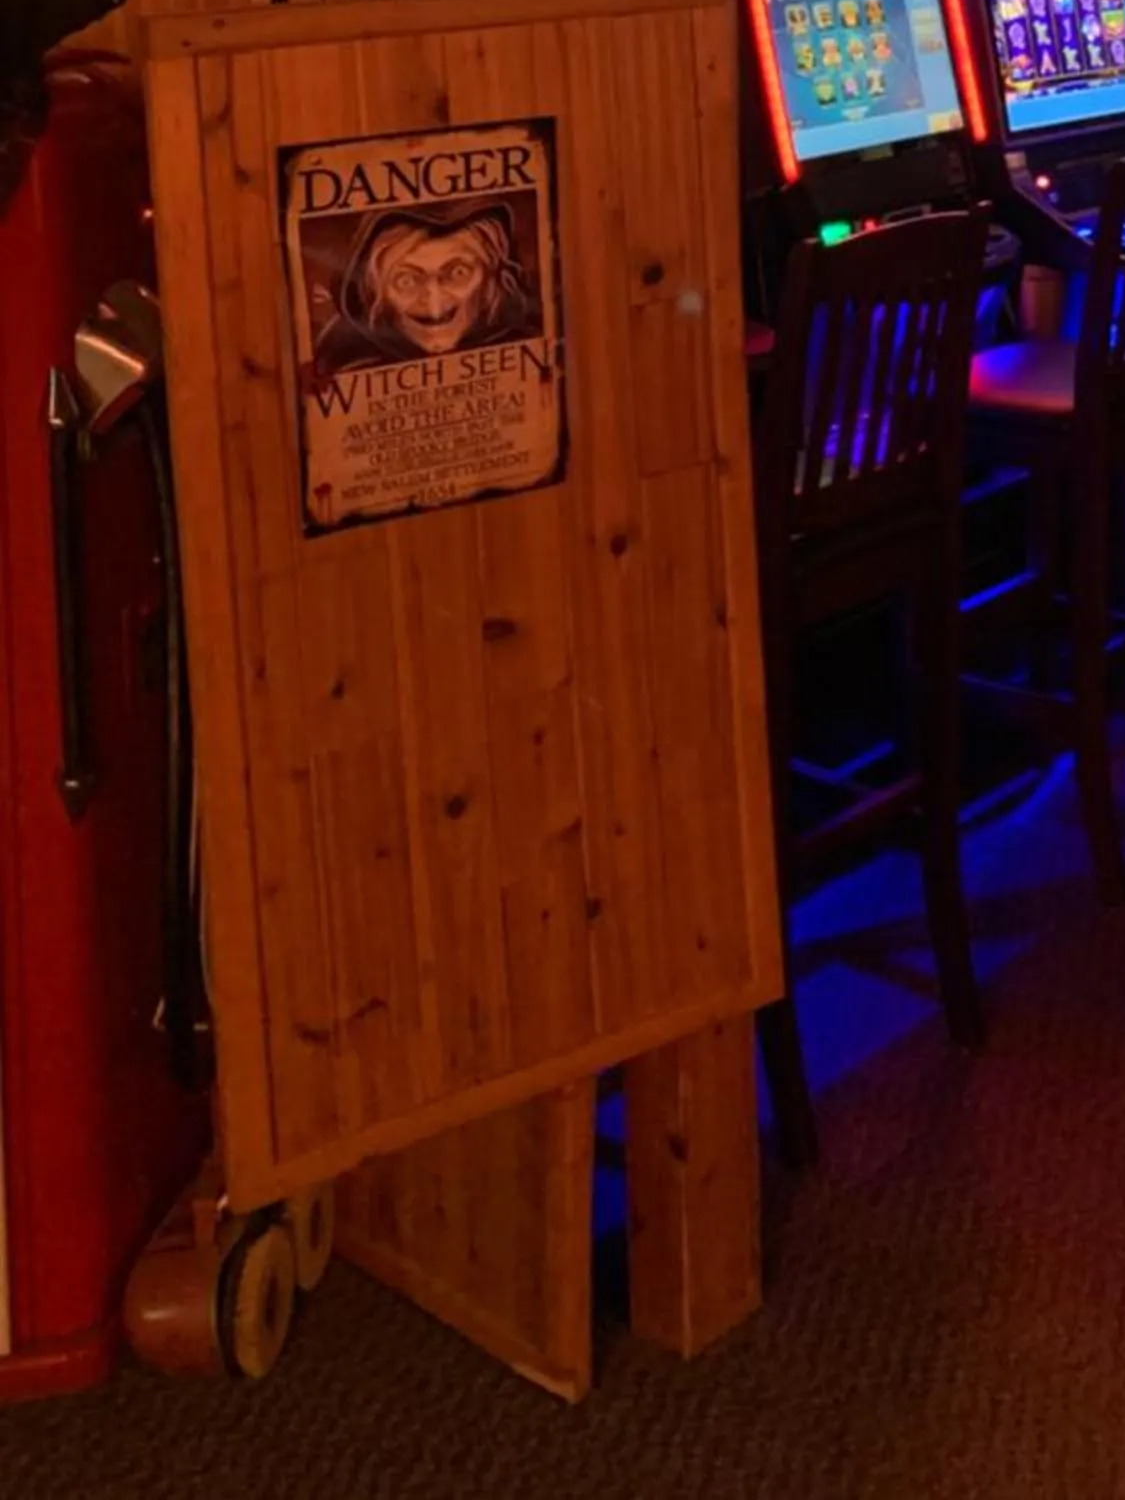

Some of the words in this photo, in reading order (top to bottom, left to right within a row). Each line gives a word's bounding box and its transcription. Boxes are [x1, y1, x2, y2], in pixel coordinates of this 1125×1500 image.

[299, 145, 535, 215] DANGER
[313, 361, 444, 419] WITCH
[459, 339, 550, 383] SEEN
[411, 405, 455, 429] THE
